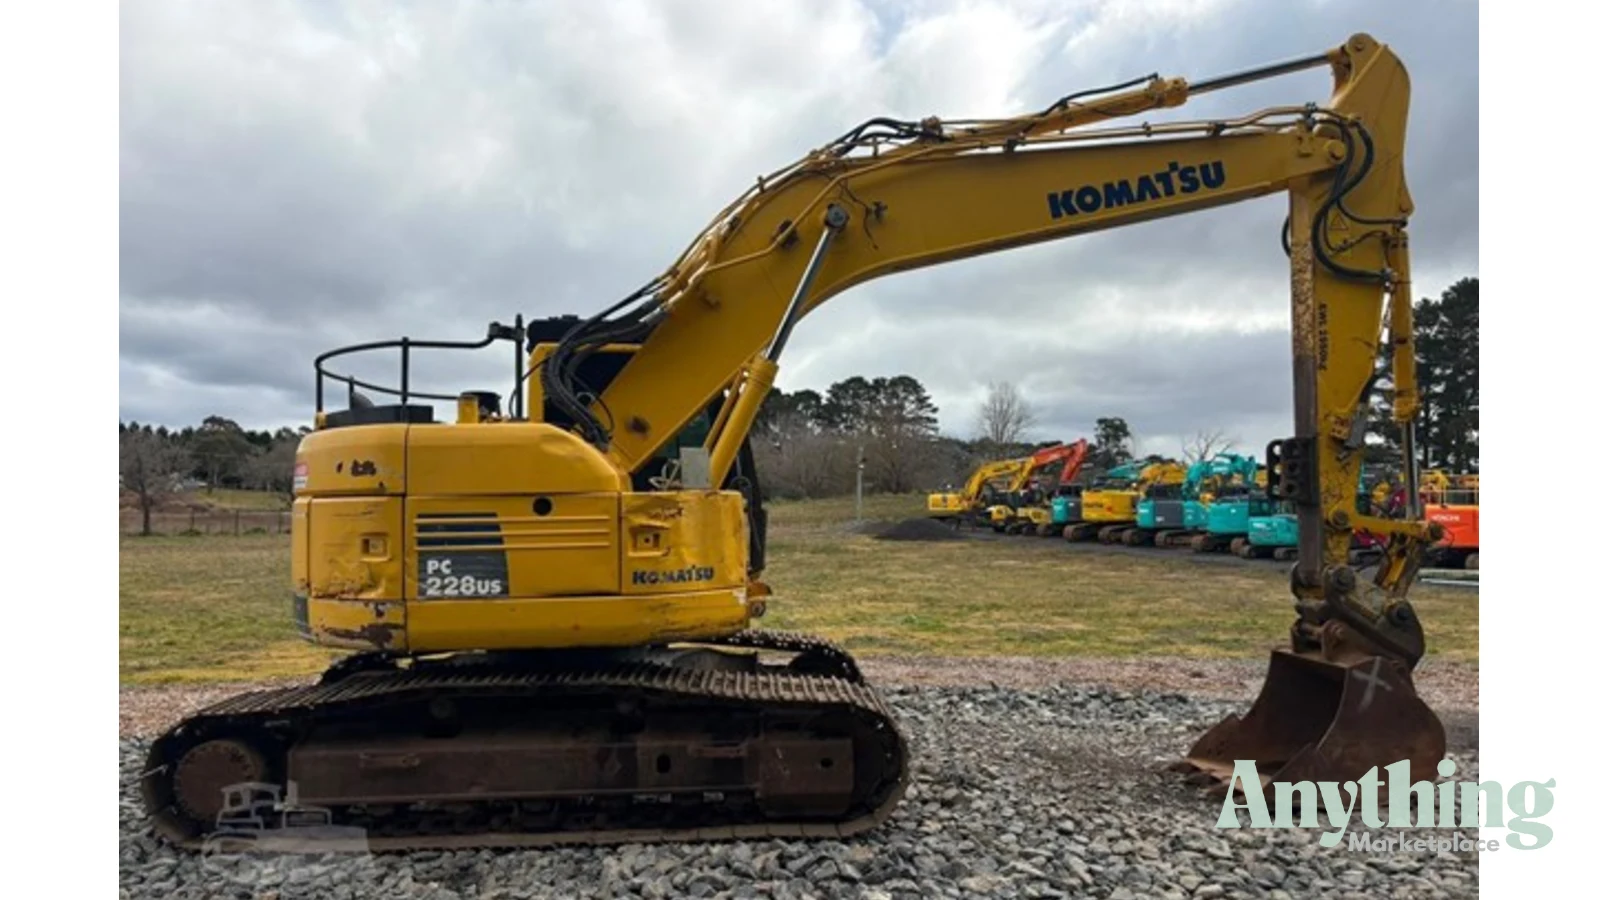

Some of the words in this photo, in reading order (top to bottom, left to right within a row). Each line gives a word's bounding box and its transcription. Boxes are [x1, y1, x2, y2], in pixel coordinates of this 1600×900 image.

[1047, 161, 1225, 219] KOMATSU
[426, 560, 452, 575] PC
[632, 565, 714, 584] KOMATSU
